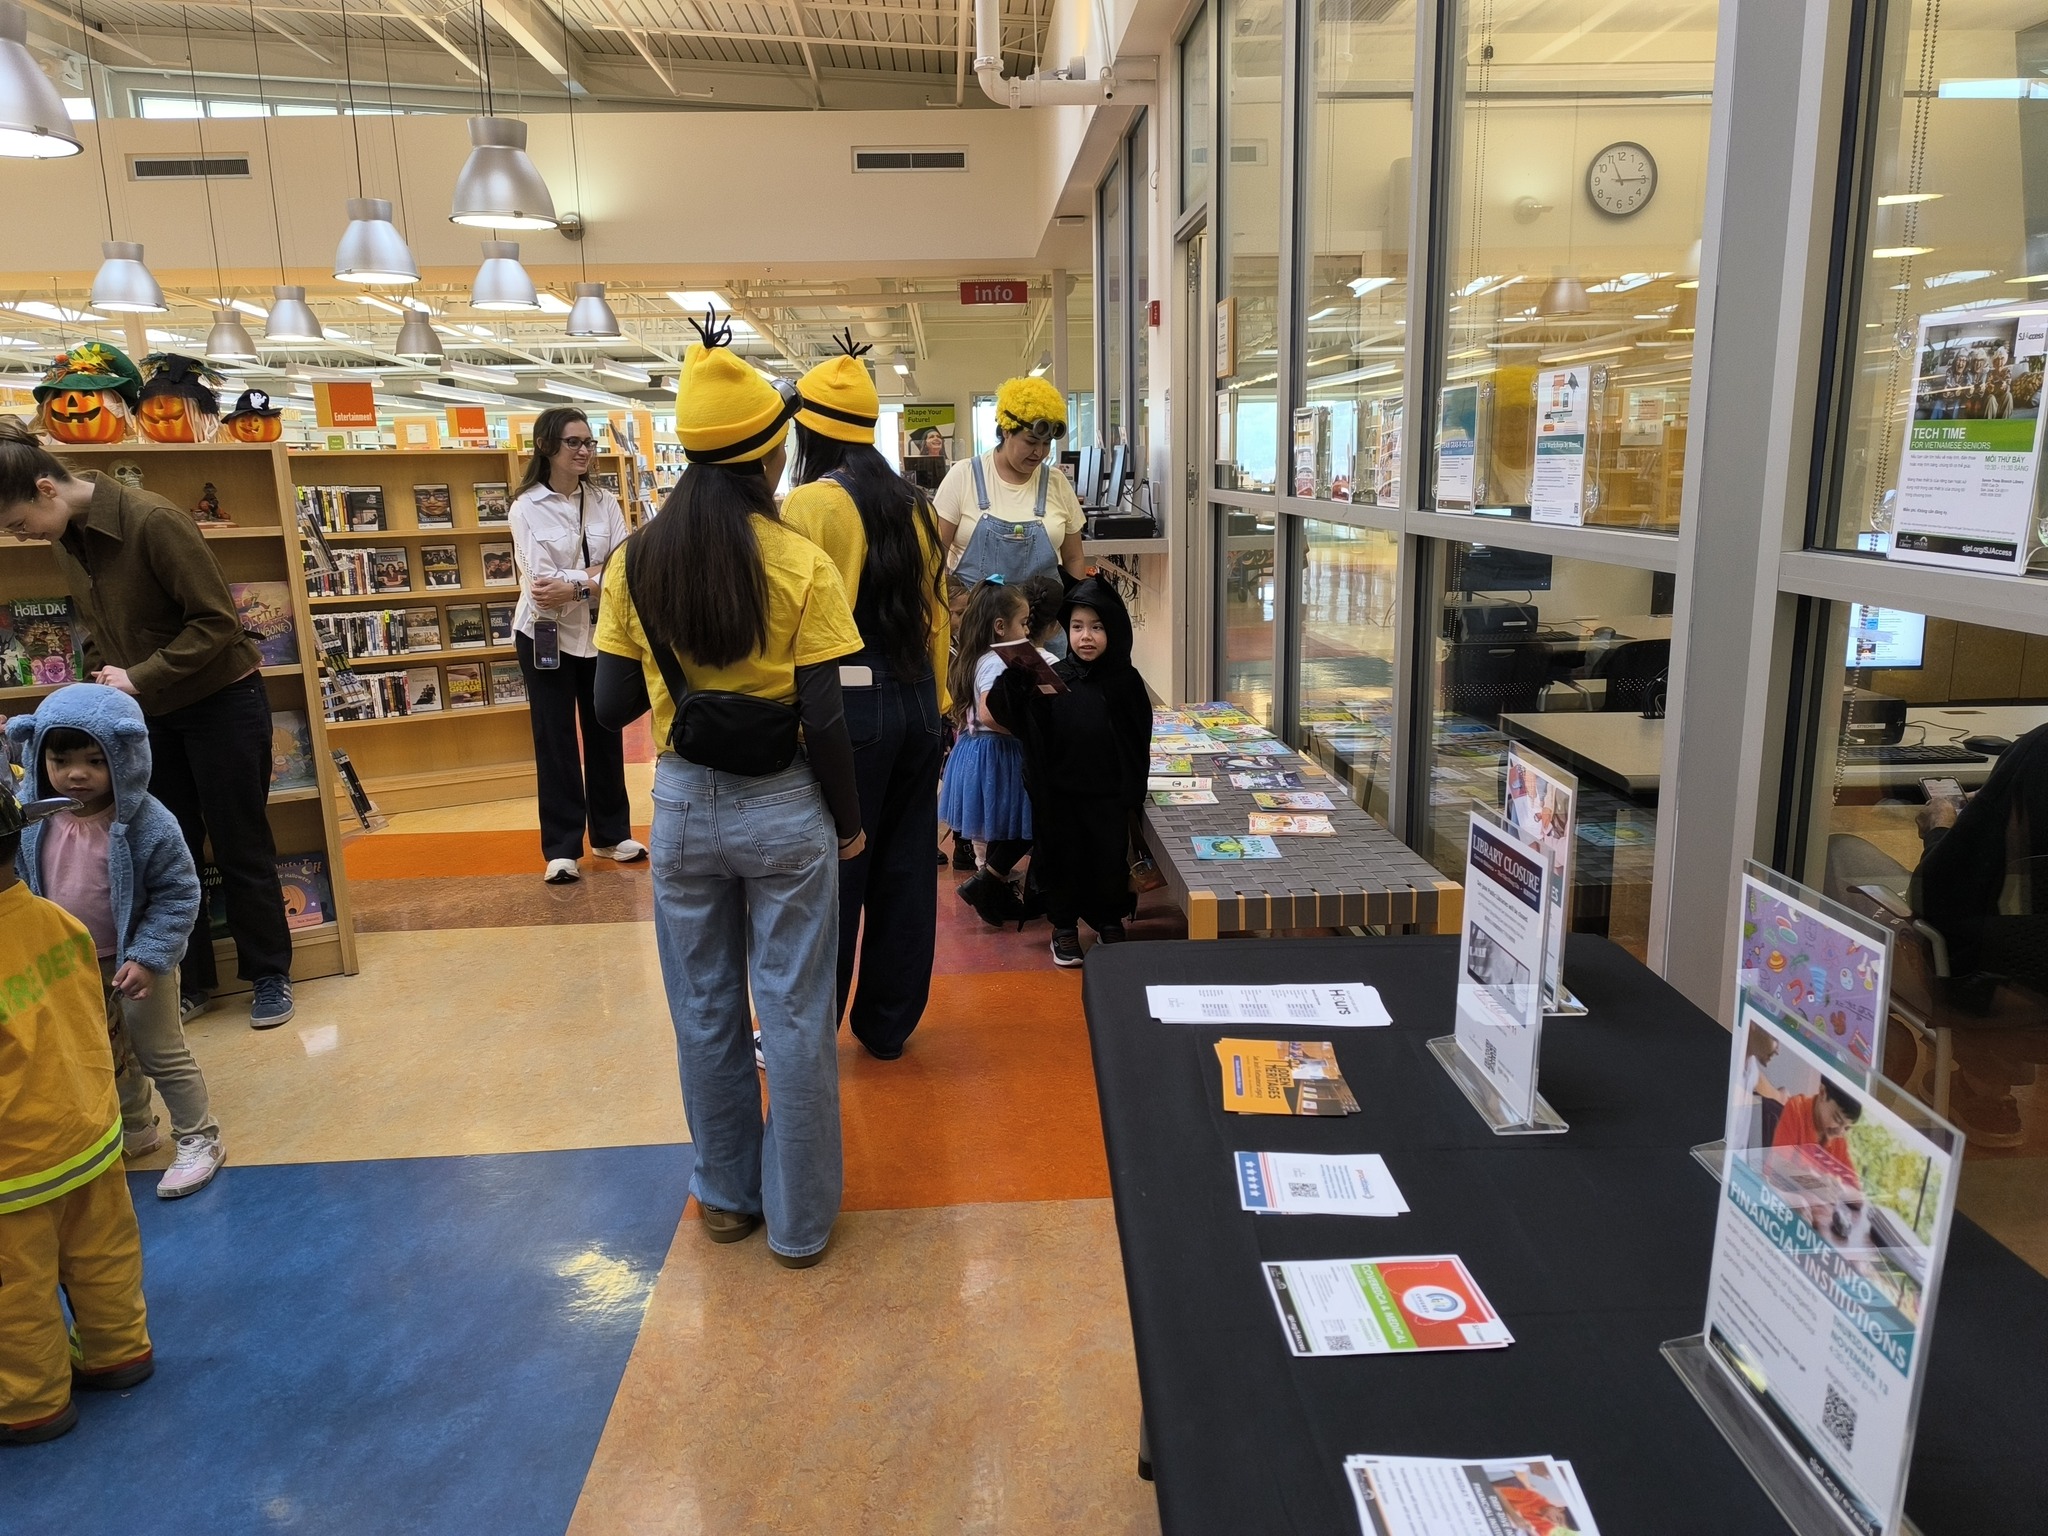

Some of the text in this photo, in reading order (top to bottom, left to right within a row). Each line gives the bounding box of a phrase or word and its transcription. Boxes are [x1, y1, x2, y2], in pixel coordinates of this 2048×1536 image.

[1608, 155, 1615, 164] 11
[1618, 152, 1626, 161] 12
[1631, 155, 1635, 163] 1
[1599, 164, 1607, 173] 10
[1638, 163, 1644, 172] 2
[1595, 177, 1600, 186] 9
[1641, 175, 1647, 185] 3
[1598, 190, 1603, 199] 8
[1636, 188, 1641, 196] 4
[1606, 197, 1612, 206] 7
[1617, 200, 1623, 209] 6
[1628, 196, 1634, 205] 5
[975, 284, 1013, 302] info
[334, 411, 372, 422] Entertainment
[907, 408, 942, 418] Shape Your
[908, 416, 930, 424] Future!
[1913, 427, 1966, 439] TECH TIME
[1911, 441, 1991, 450] FOR VIETNAMESE SENIORS
[14, 604, 44, 617] HOTEL
[241, 606, 283, 632] BEETLE
[449, 679, 481, 687] EIGHTH
[449, 685, 481, 693] GRADE
[1472, 833, 1504, 870] LIBRARY
[1503, 851, 1540, 893] CLOSURE
[1328, 989, 1352, 1016] Hours
[1759, 1184, 1873, 1309] DEEP DIVE INTO
[1729, 1180, 1907, 1372] FINANCIAL INSTITUTIONS
[1361, 1264, 1386, 1309] COVEREDCA
[1385, 1310, 1407, 1345] MEDICAL
[1830, 1328, 1876, 1383] NOVEMBER
[1473, 1482, 1492, 1517] FINANCIAL
